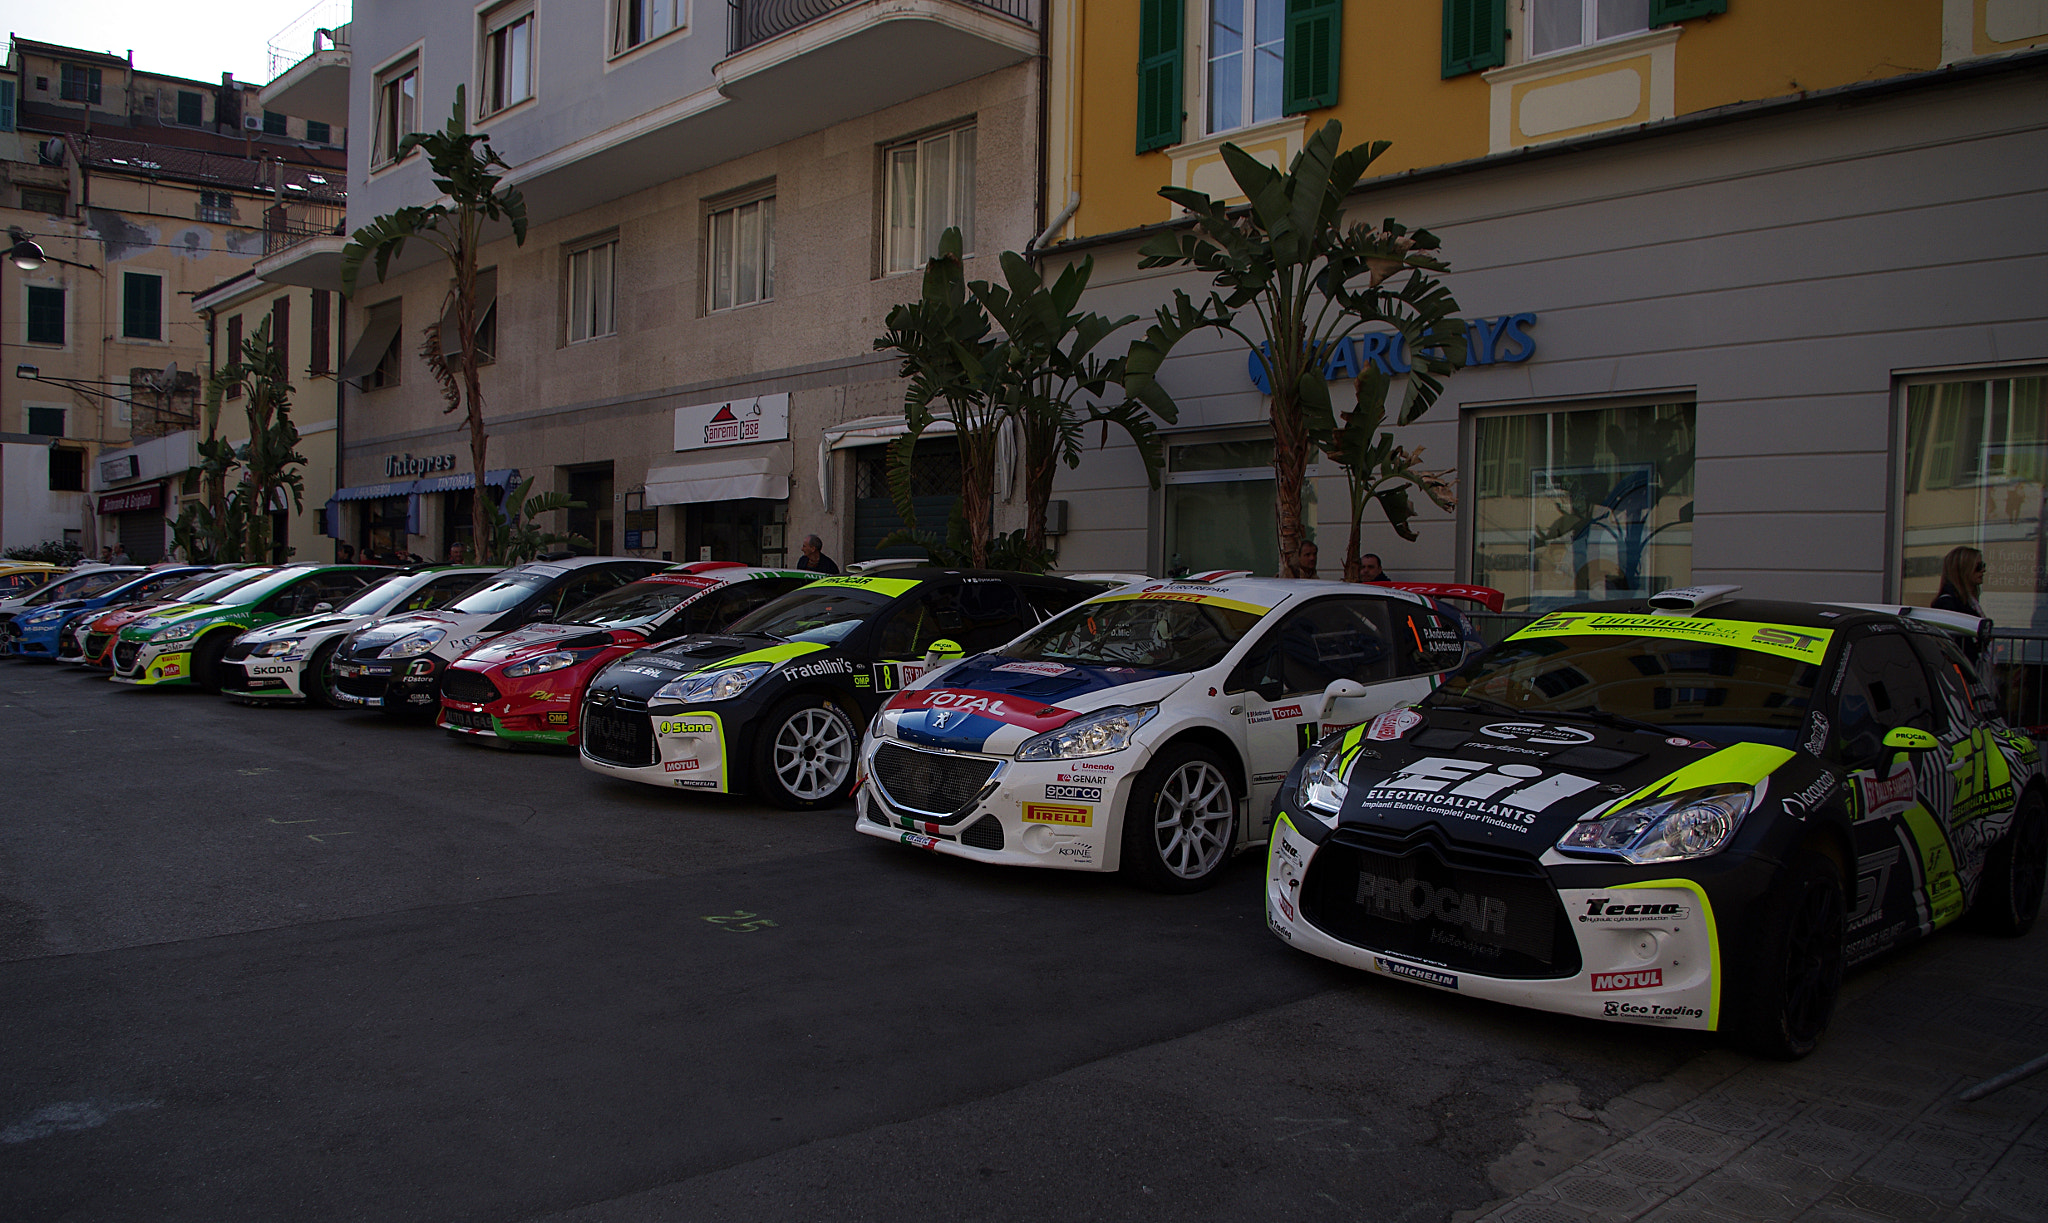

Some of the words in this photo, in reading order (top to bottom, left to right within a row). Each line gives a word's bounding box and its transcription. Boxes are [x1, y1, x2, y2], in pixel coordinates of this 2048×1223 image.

[704, 425, 738, 444] Sanremo
[740, 420, 759, 440] Case
[1138, 593, 1207, 602] PIRELLI
[1529, 616, 1586, 630] ST
[1591, 615, 1715, 631] Euromont
[1751, 639, 1814, 654] MACCHINE
[1753, 628, 1824, 649] ST
[253, 665, 293, 675] ŠKODA
[782, 657, 853, 682] Fratellini's
[883, 665, 892, 689] 8
[854, 677, 870, 685] OMP
[923, 691, 1005, 717] TOTAL
[465, 714, 473, 725] A
[549, 715, 568, 723] OMP
[1273, 708, 1302, 719] TOTAL
[673, 722, 713, 733] Stone
[1304, 723, 1311, 750] 1
[666, 761, 698, 771] MOTUL
[1082, 763, 1115, 771] Unendo
[1072, 775, 1107, 785] GENART
[1046, 785, 1101, 800] sparco
[1027, 805, 1088, 824] PIRELLI
[1366, 789, 1537, 825] ELECTRICALPLANTS
[1361, 801, 1393, 810] Impianti
[1393, 802, 1425, 813] Elettrici
[1426, 806, 1464, 820] completi
[1464, 812, 1481, 823] per
[1481, 814, 1529, 835] l'industria
[1586, 897, 1679, 916] Tecno
[1393, 963, 1454, 986] MICHELIN
[1595, 971, 1660, 990] MOTUL
[1620, 1002, 1649, 1015] Geo
[1651, 1005, 1703, 1018] Trading
